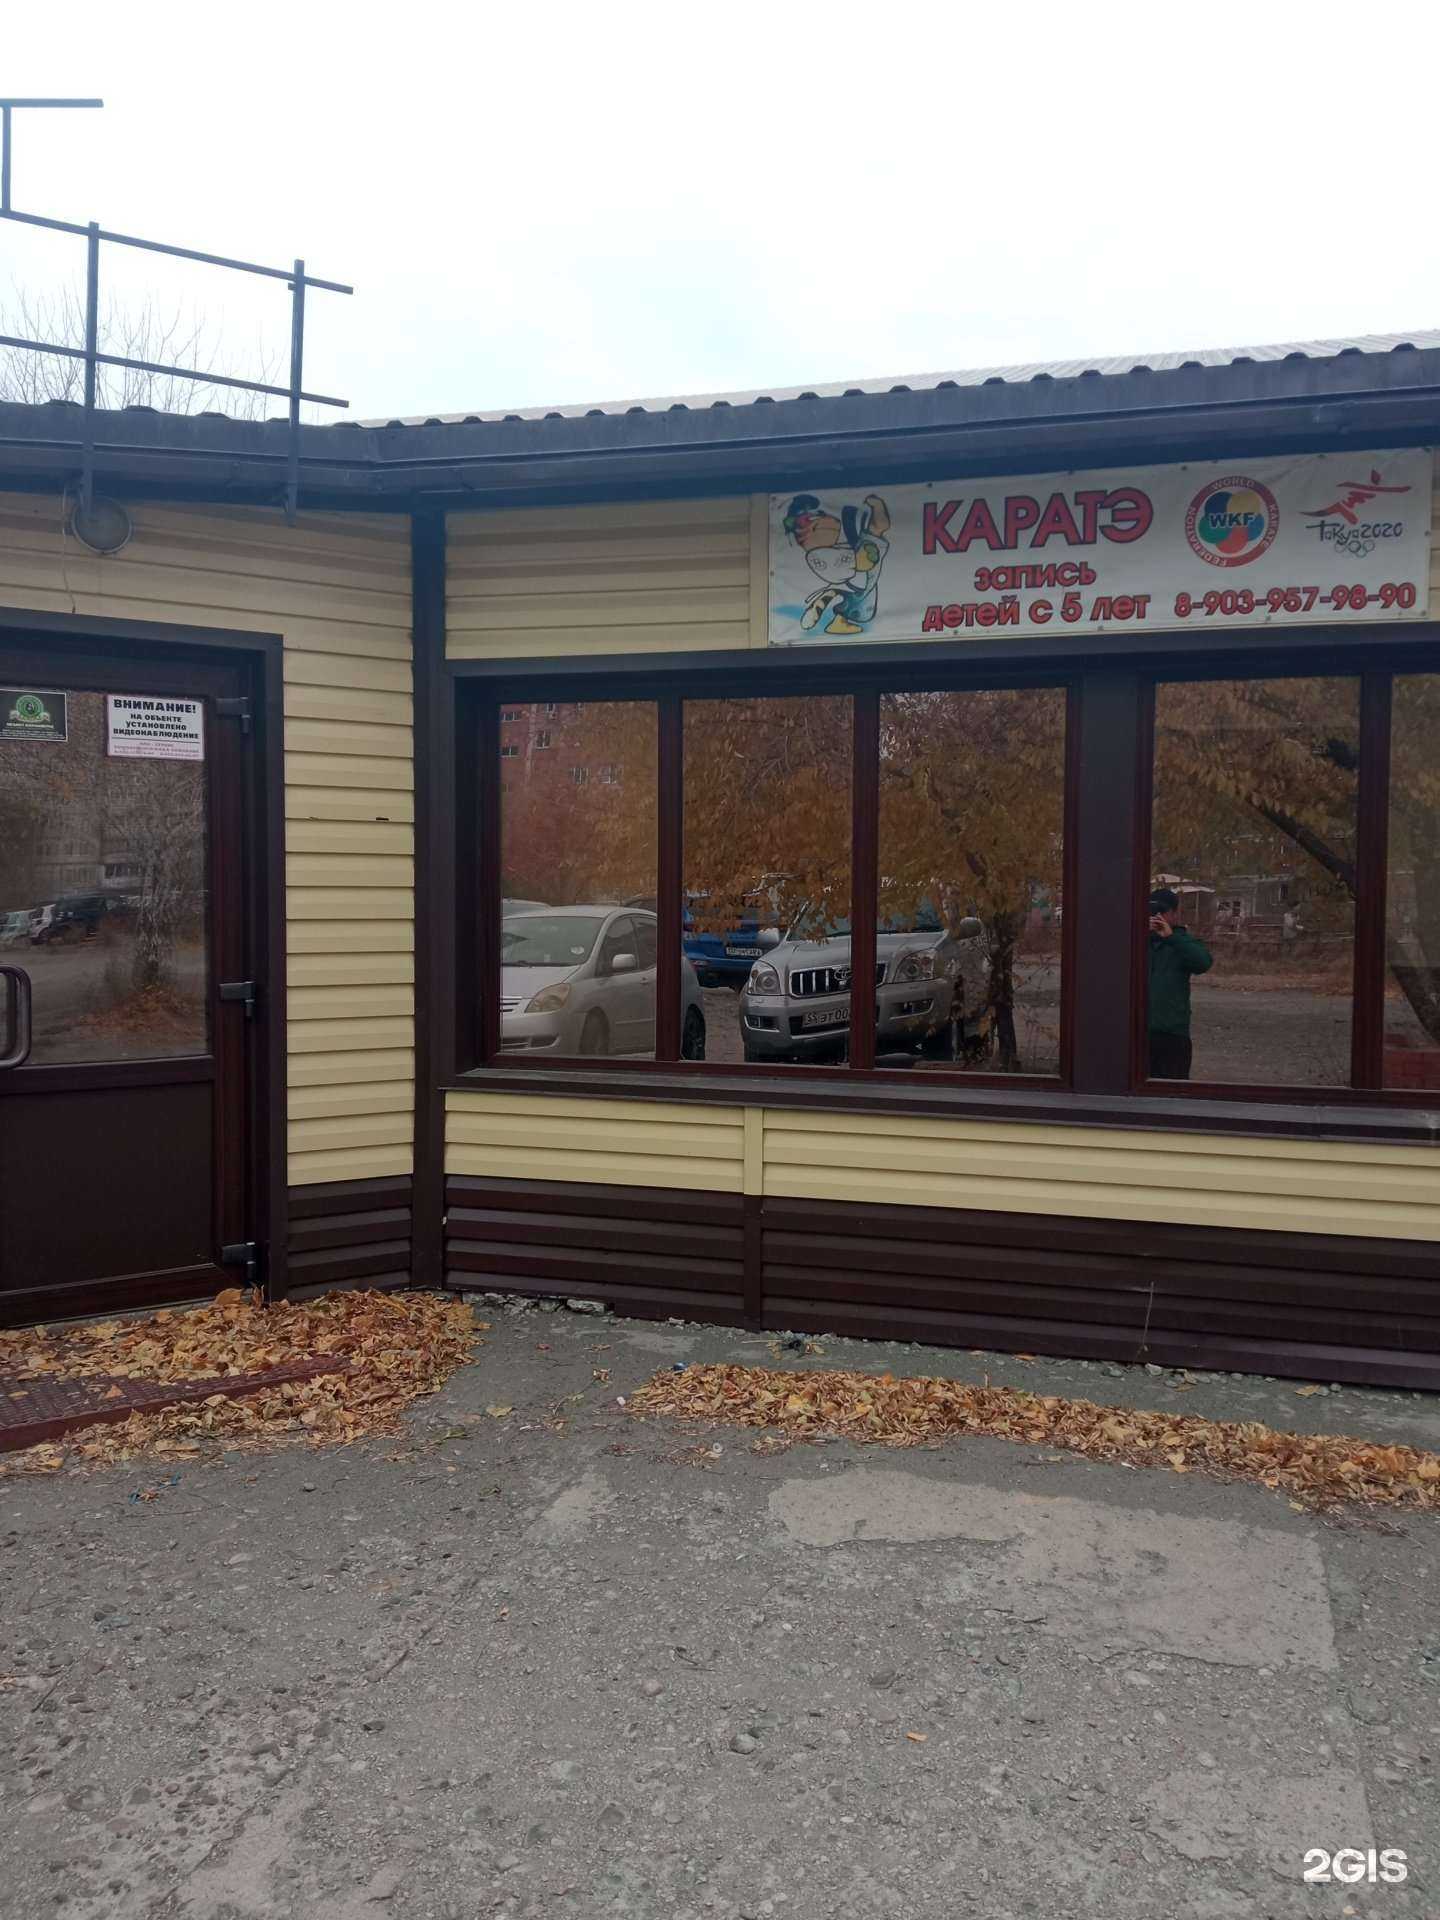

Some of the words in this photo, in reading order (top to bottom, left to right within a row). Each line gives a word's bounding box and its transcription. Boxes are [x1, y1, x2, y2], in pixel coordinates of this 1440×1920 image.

[922, 486, 1154, 555] КАРАТЭ
[1208, 512, 1256, 528] WKF
[974, 561, 1097, 591] запись
[1174, 582, 1417, 618] 8-903-957-98-90
[922, 595, 1020, 632] детей
[1028, 599, 1053, 624] с
[1060, 592, 1083, 623] 5
[1089, 595, 1151, 621] лет
[113, 699, 196, 713] ВНИМАНИЕ!
[113, 728, 199, 739] ВИДЕОНАБЛЮДЕНИЕ
[126, 721, 187, 731] УСТАНОВЛЕНО
